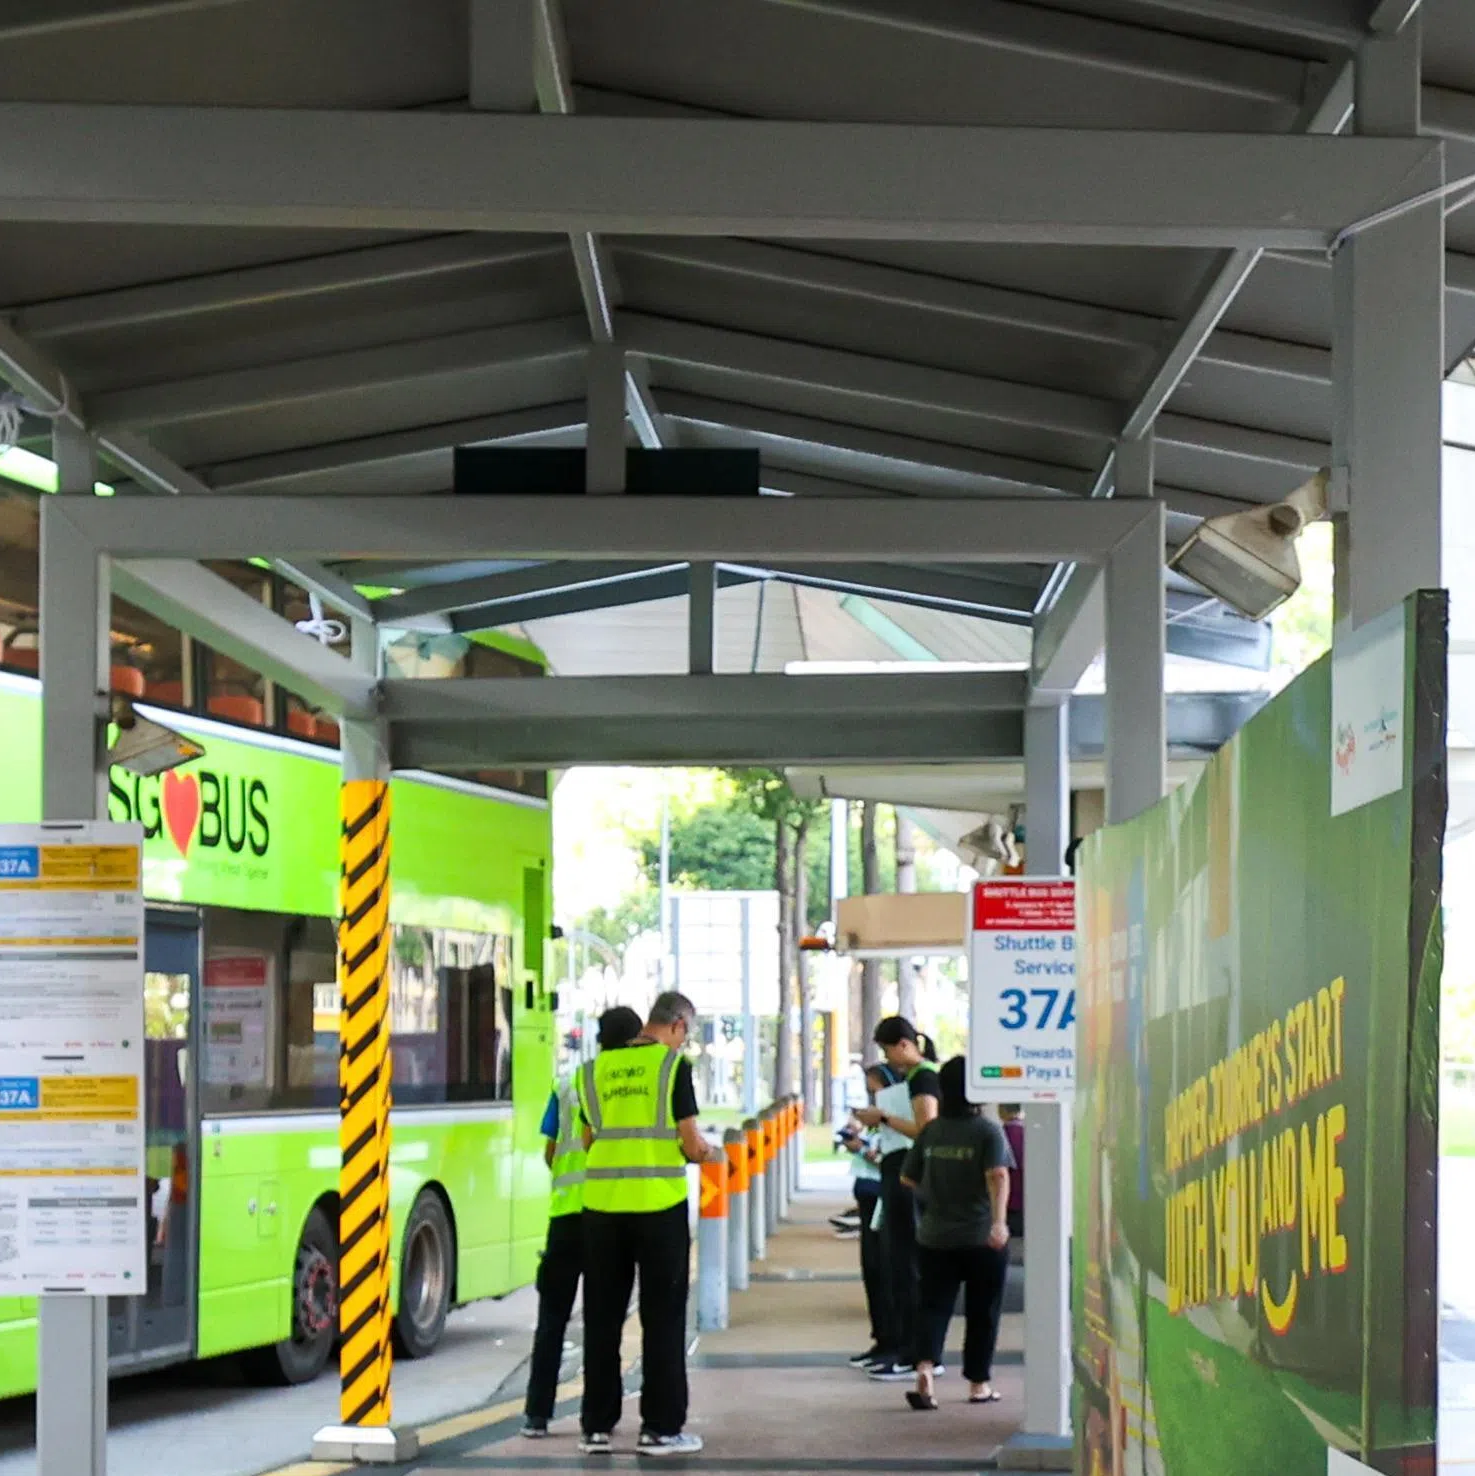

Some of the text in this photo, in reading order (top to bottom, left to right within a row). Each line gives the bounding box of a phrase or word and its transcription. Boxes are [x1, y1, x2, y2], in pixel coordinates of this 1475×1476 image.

[198, 769, 270, 857] BUS
[994, 935, 1057, 952] Shuttle
[1013, 959, 1076, 976] Service
[1012, 1044, 1074, 1060] Towards
[1025, 1063, 1062, 1082] Paya
[1209, 1018, 1283, 1151] JOURNEYS
[1284, 975, 1345, 1106] START
[1165, 1103, 1348, 1316] WITH YOU AND ME
